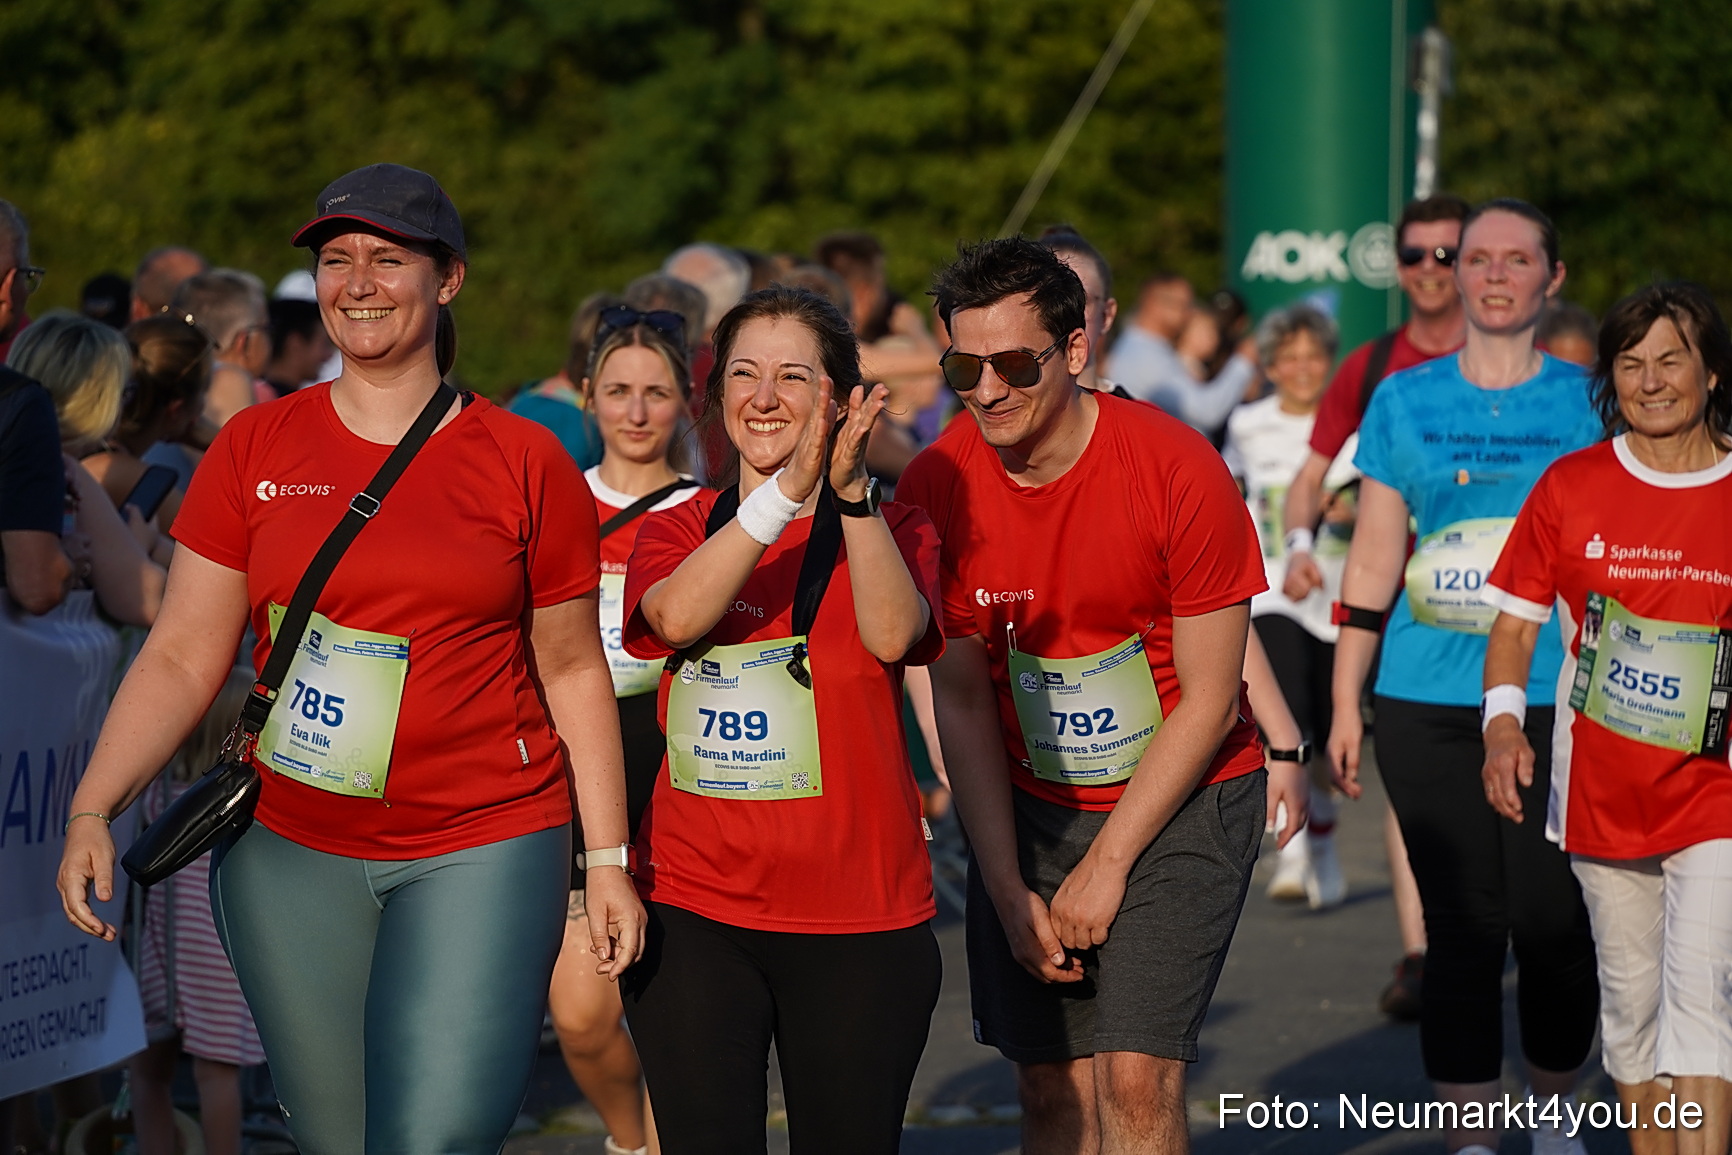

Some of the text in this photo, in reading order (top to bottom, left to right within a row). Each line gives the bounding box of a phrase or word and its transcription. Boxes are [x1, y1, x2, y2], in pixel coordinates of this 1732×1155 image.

[1241, 229, 1349, 283] AOK
[1423, 432, 1561, 447] Wir halten Immobilien
[1452, 452, 1472, 462] am
[1610, 544, 1683, 562] Sparkasse
[725, 600, 764, 618] COVIS
[993, 589, 1035, 603] ECOVIS
[696, 674, 739, 685] Firmenlauf
[1040, 682, 1082, 691] Firmenlauf
[1608, 657, 1681, 700] 2555
[289, 678, 346, 728] 785
[1601, 684, 1625, 706] Maria
[1627, 697, 1686, 721] Großmann
[290, 722, 332, 749] Eva Ilik
[698, 707, 769, 741] 789
[1049, 707, 1119, 737] 792
[1034, 724, 1155, 754] Johannes Summerer
[693, 744, 786, 762] Rama Mardini
[0, 996, 106, 1062] RGEN GEMACHT
